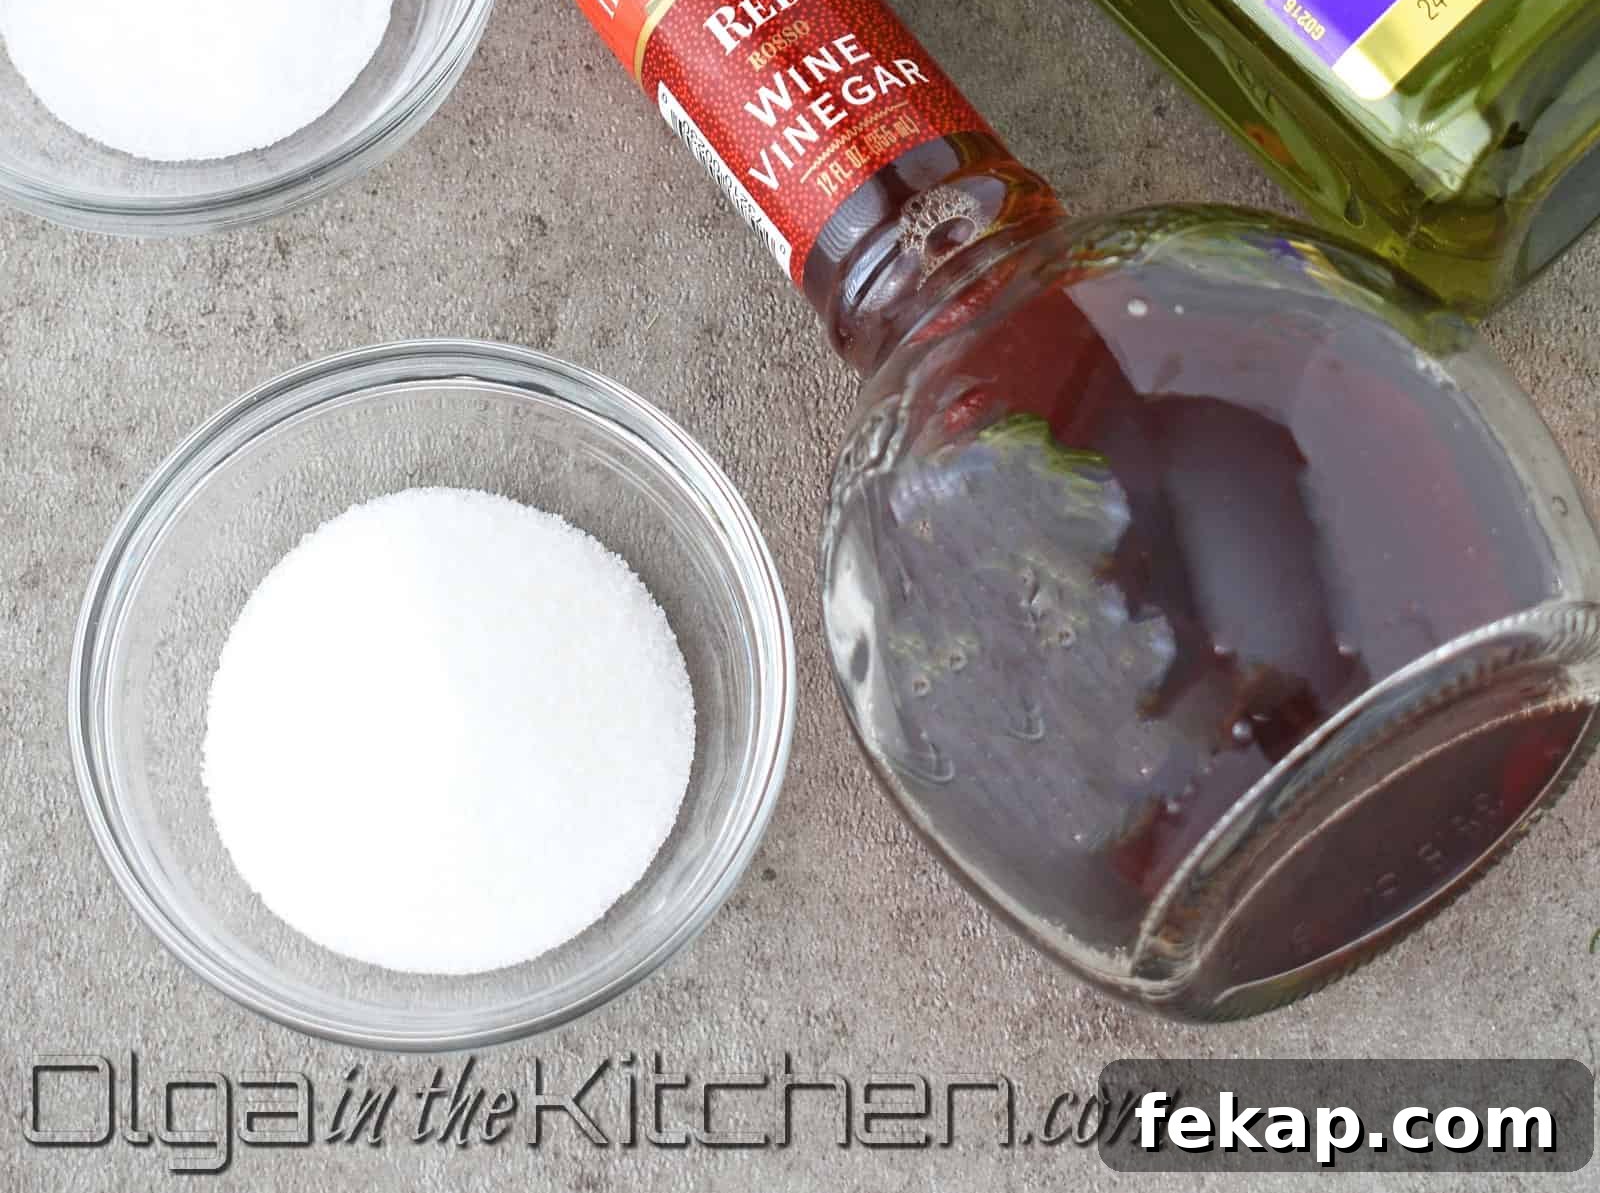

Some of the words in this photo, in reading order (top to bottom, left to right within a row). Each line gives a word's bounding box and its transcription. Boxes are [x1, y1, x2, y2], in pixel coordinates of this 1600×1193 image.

[744, 33, 872, 128] WINE
[747, 20, 810, 72] ROSSO
[748, 59, 929, 191] VINEGAR
[817, 171, 838, 198] 12
